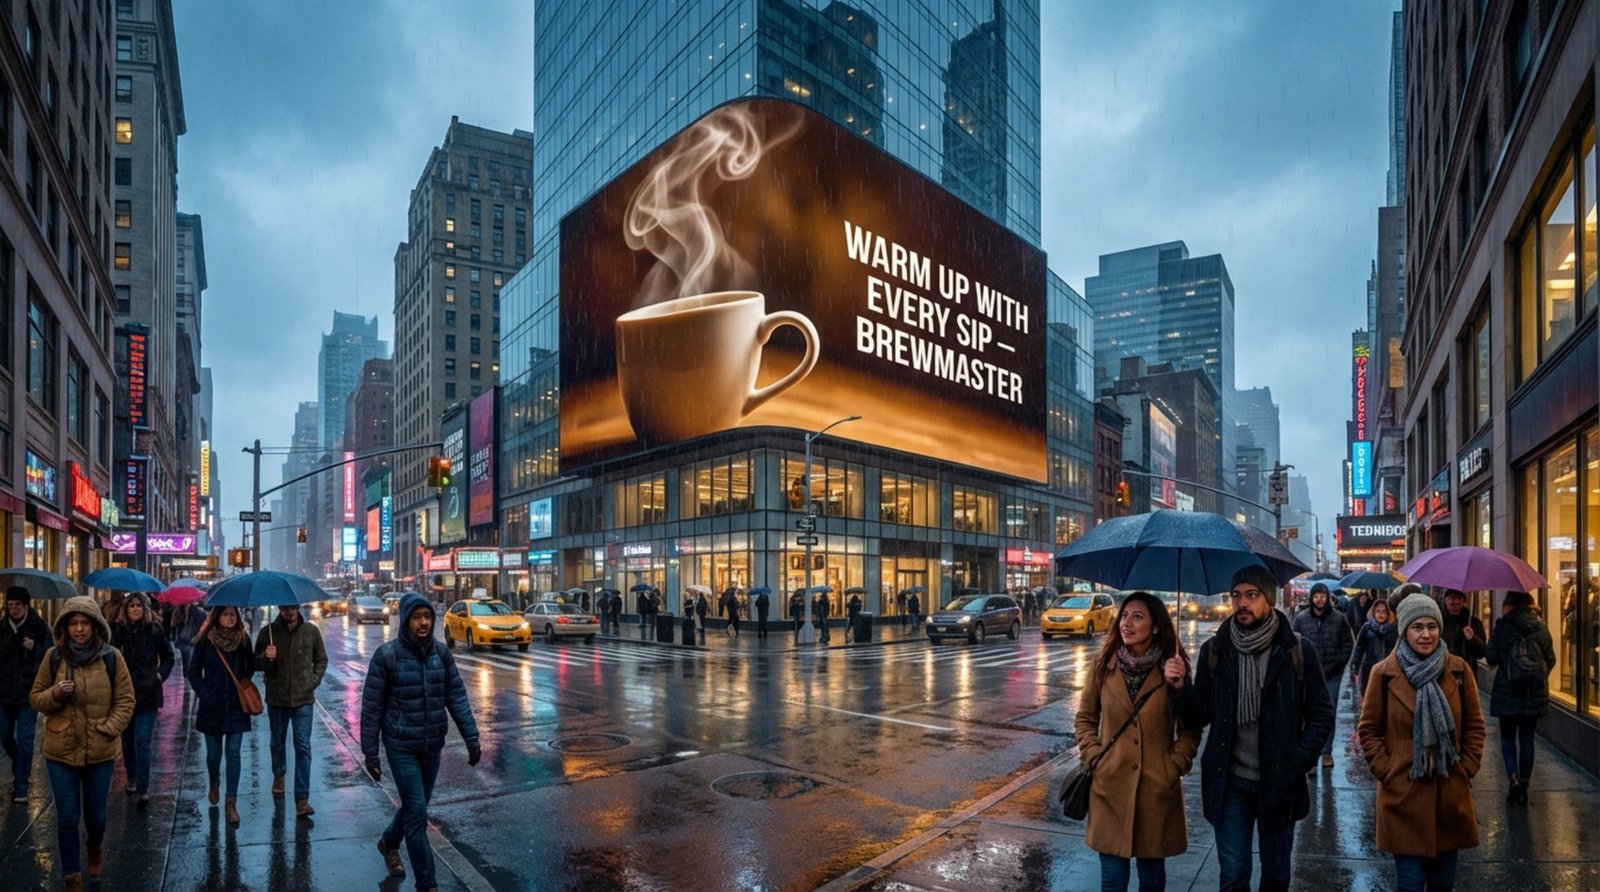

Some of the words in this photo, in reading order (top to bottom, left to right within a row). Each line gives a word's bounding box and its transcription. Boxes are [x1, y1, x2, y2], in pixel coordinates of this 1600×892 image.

[844, 220, 931, 291] WARM
[939, 264, 970, 304] UP
[975, 281, 1029, 334] WITH
[867, 275, 950, 338] EVERY
[956, 313, 992, 352] SIP
[856, 315, 1023, 404] BREWMASTER
